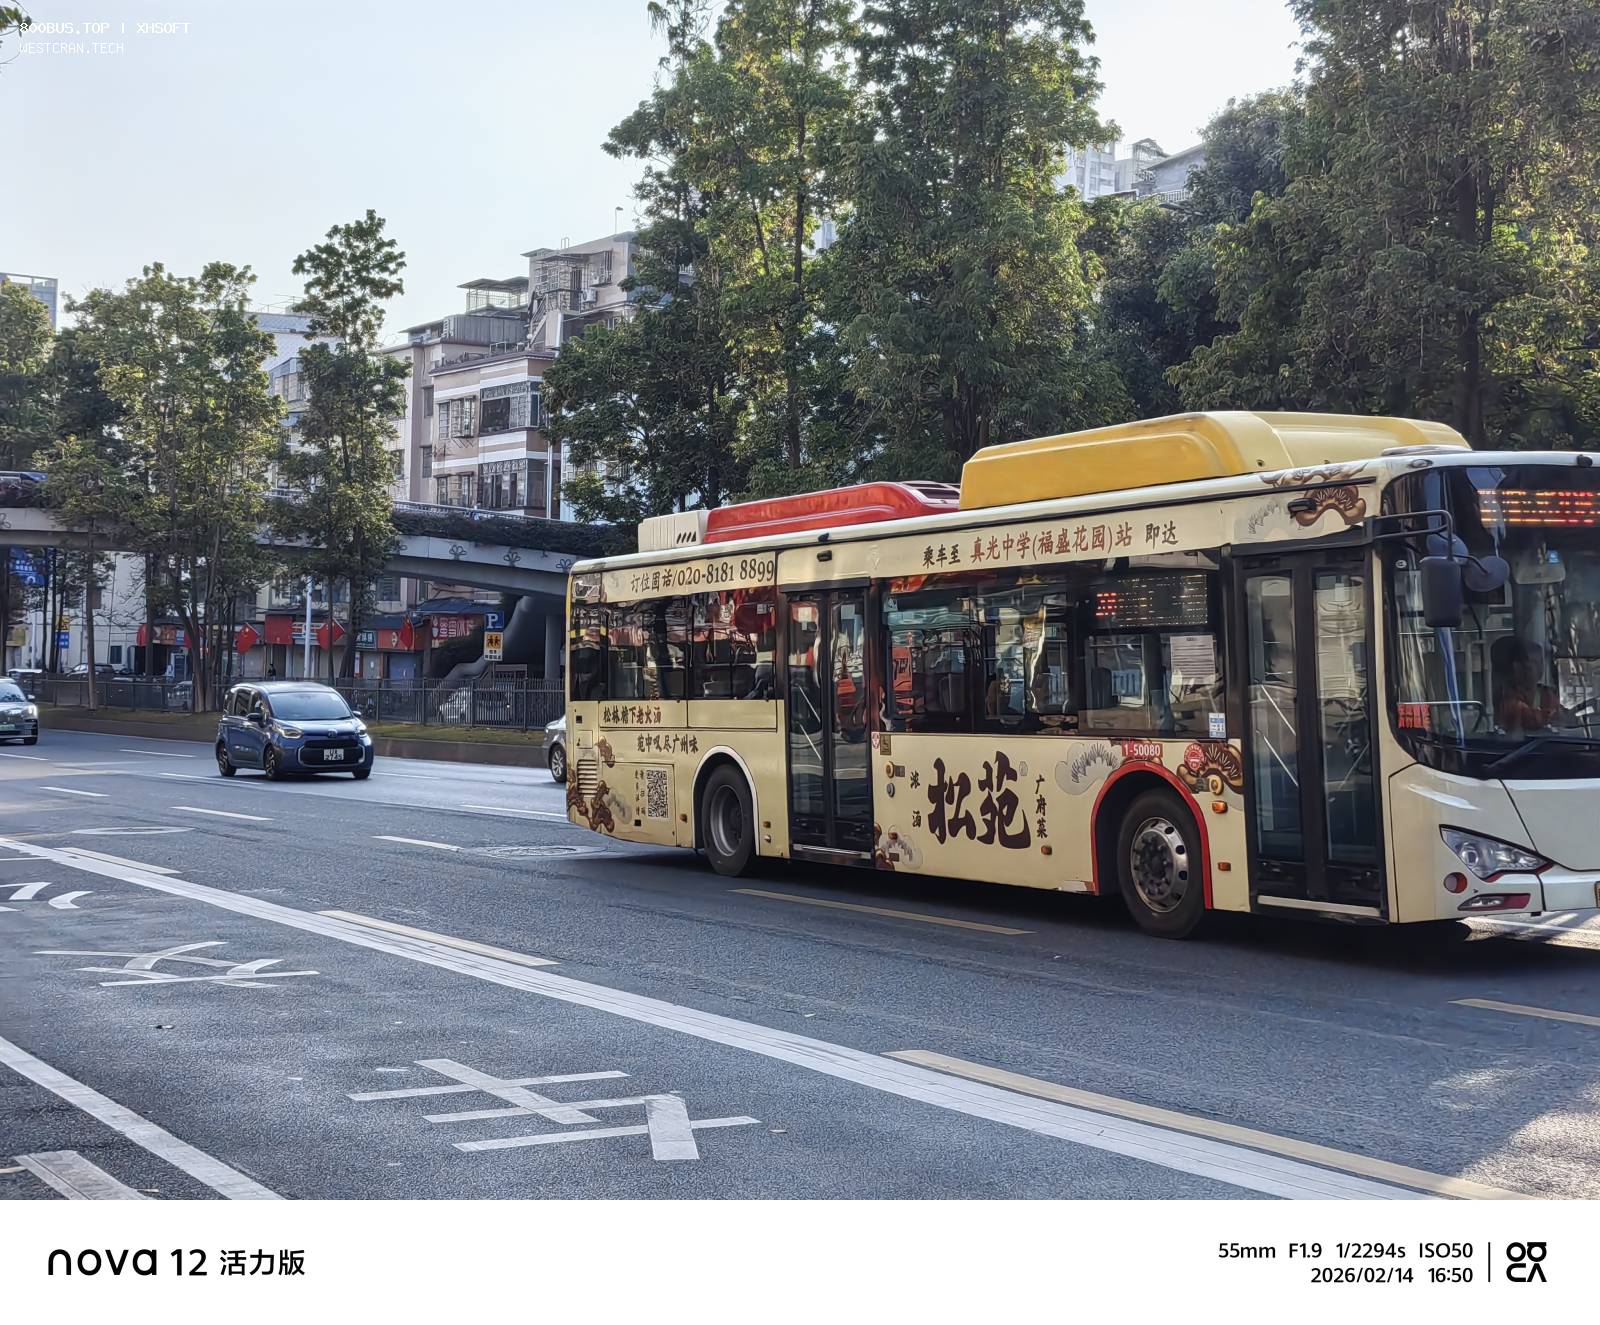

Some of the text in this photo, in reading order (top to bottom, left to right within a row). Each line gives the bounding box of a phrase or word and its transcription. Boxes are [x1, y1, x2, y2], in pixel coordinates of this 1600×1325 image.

[922, 519, 1179, 569] 乘车至 真光中学(福盛花园)站 即达
[739, 558, 775, 583] 8899
[485, 613, 499, 629] P
[1124, 743, 1162, 757] 1-50080
[928, 751, 1031, 849] 松苑
[1035, 774, 1048, 838] 广府菜
